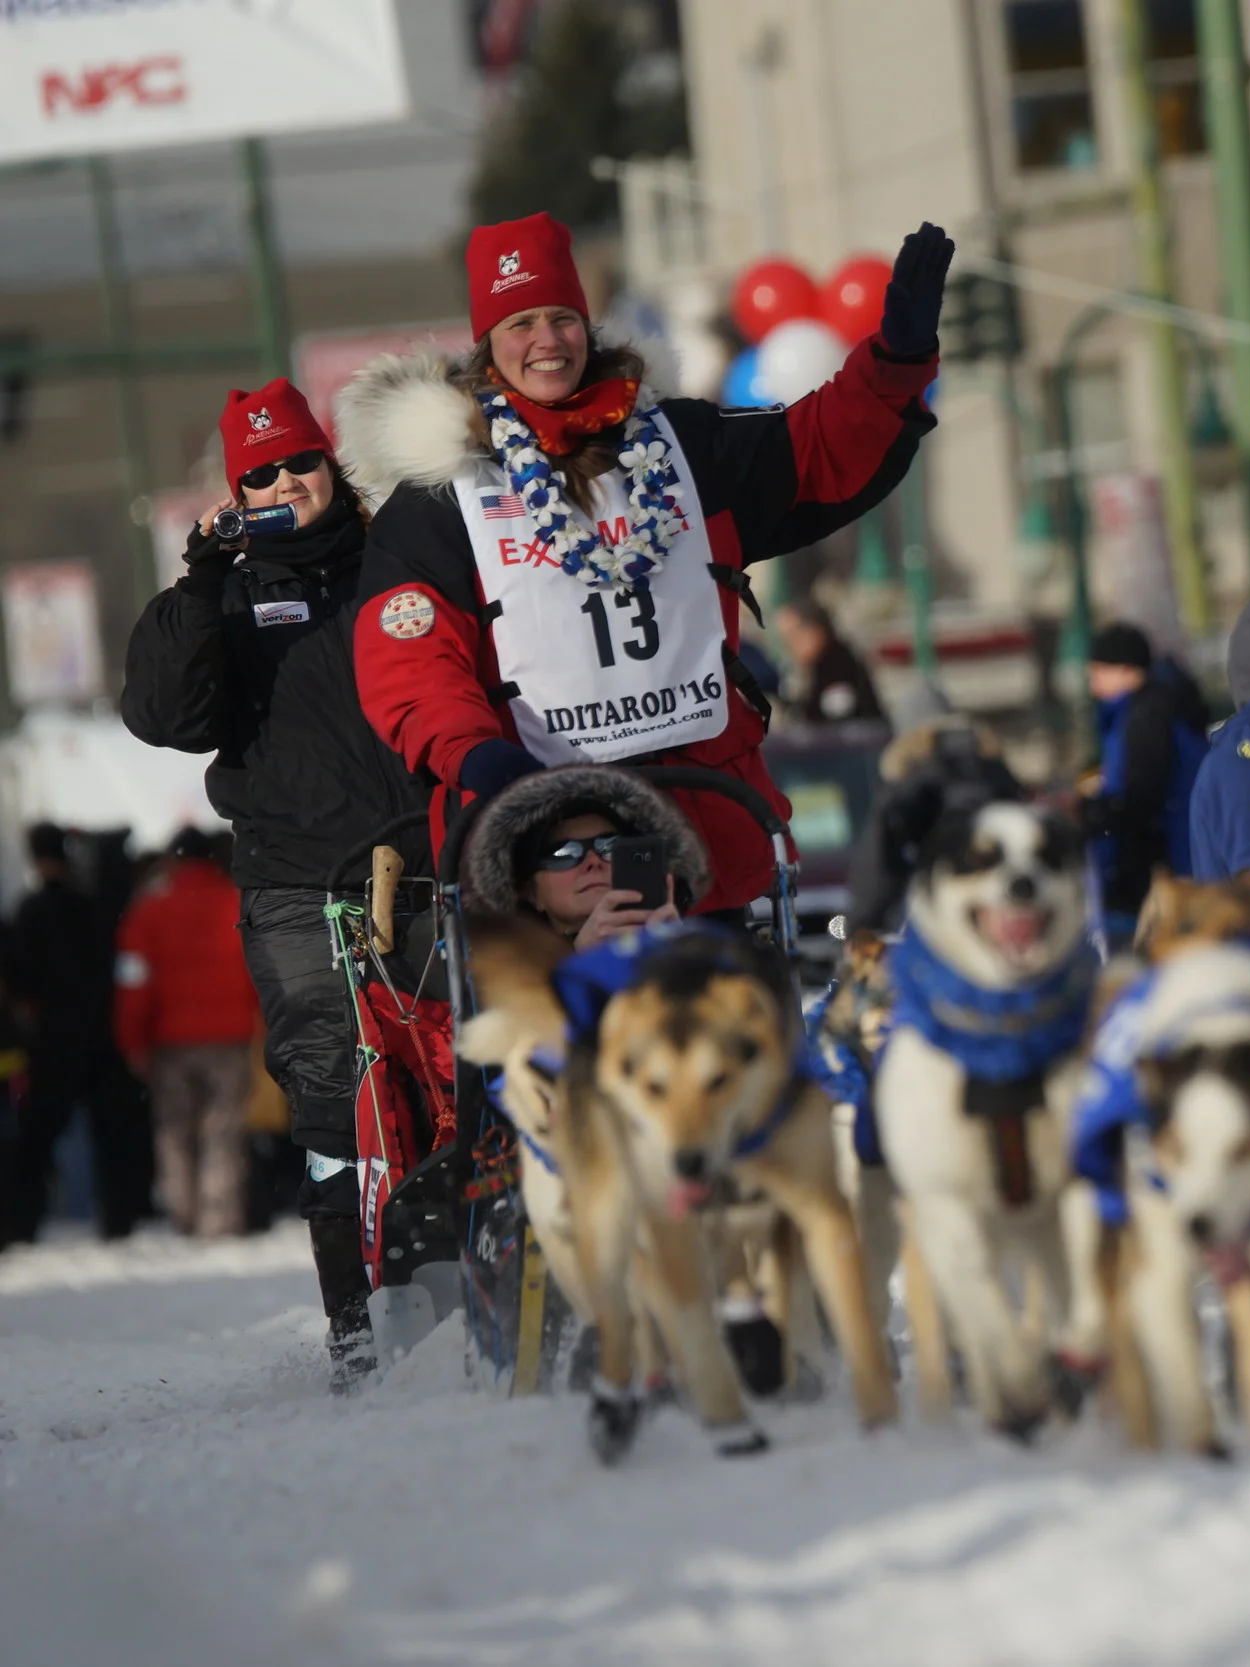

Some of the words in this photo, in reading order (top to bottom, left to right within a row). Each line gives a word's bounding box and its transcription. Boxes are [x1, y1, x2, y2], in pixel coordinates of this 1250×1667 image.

[262, 613, 303, 623] verizon
[580, 588, 660, 668] 13
[543, 686, 677, 735] IDITAROD
[679, 672, 722, 705] '16
[568, 708, 713, 748] www.iditarod.com
